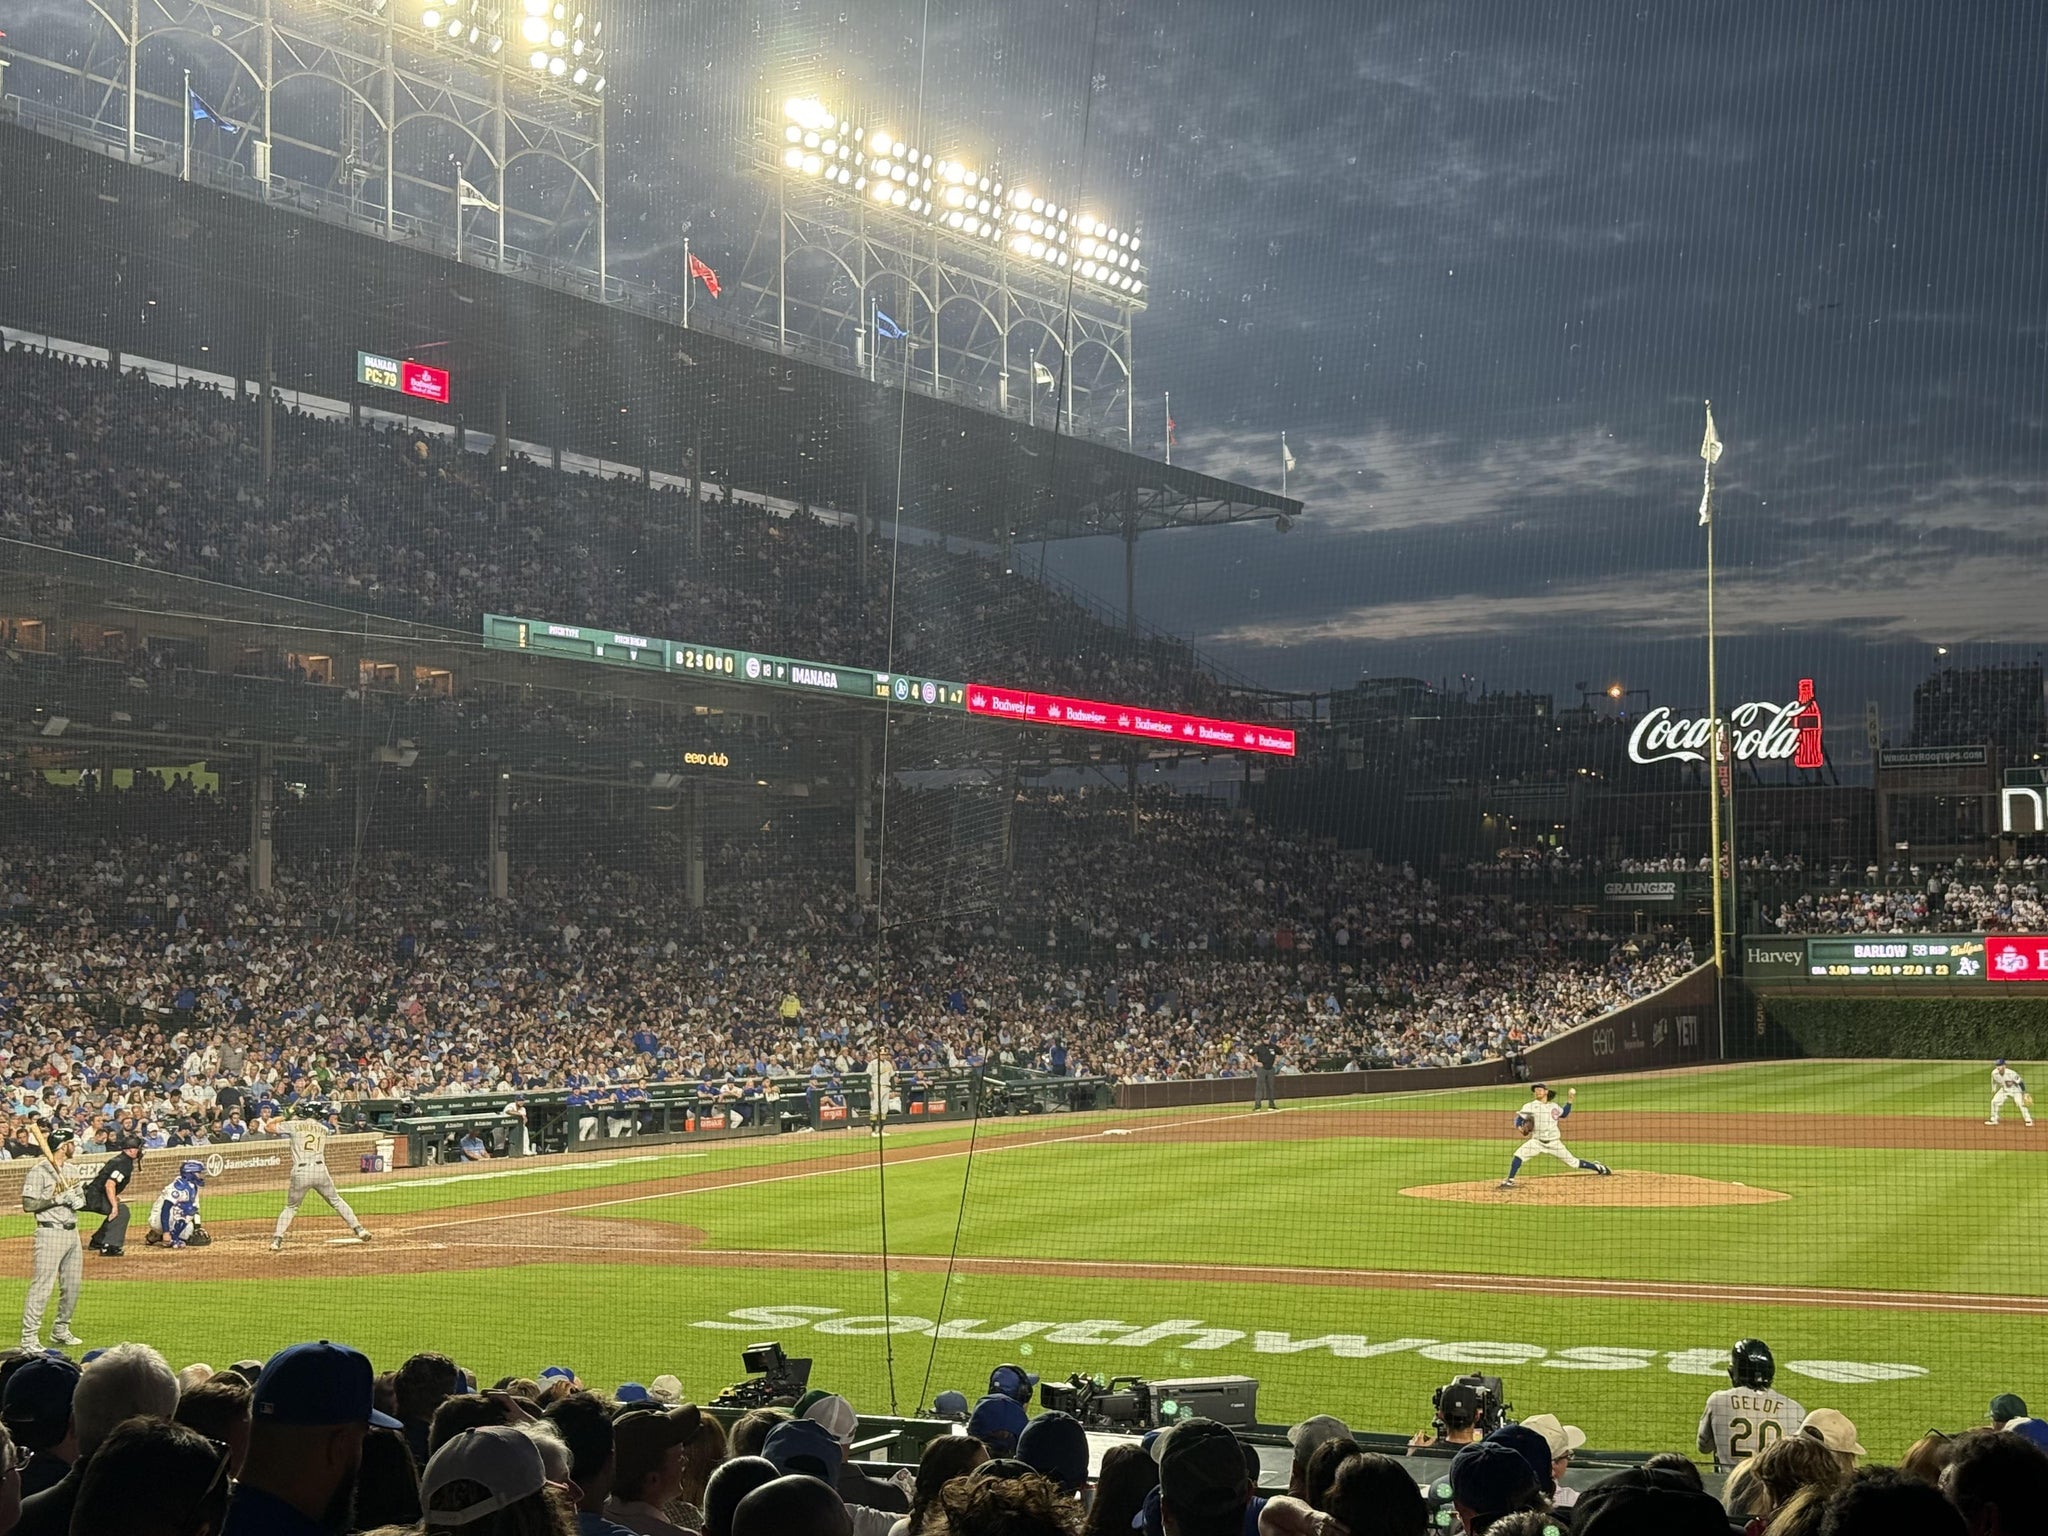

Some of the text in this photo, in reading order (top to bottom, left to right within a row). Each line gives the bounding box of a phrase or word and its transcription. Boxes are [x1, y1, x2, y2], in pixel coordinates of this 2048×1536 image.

[384, 371, 397, 387] 79
[685, 651, 695, 668] 2
[704, 653, 715, 671] 0
[724, 656, 734, 673] 0
[792, 667, 838, 688] IMANAGA
[911, 683, 919, 699] 4
[1604, 882, 1676, 894] GRAINGER
[1747, 948, 1803, 966] Harvey
[1854, 944, 1908, 958] BARLOW
[1675, 1015, 1698, 1047] YETI
[303, 1134, 321, 1151] 21
[224, 1156, 281, 1169] JamesHardie
[684, 1305, 1733, 1377] Southwest
[1731, 1394, 1785, 1415] GELOF
[1729, 1417, 1783, 1458] 20
